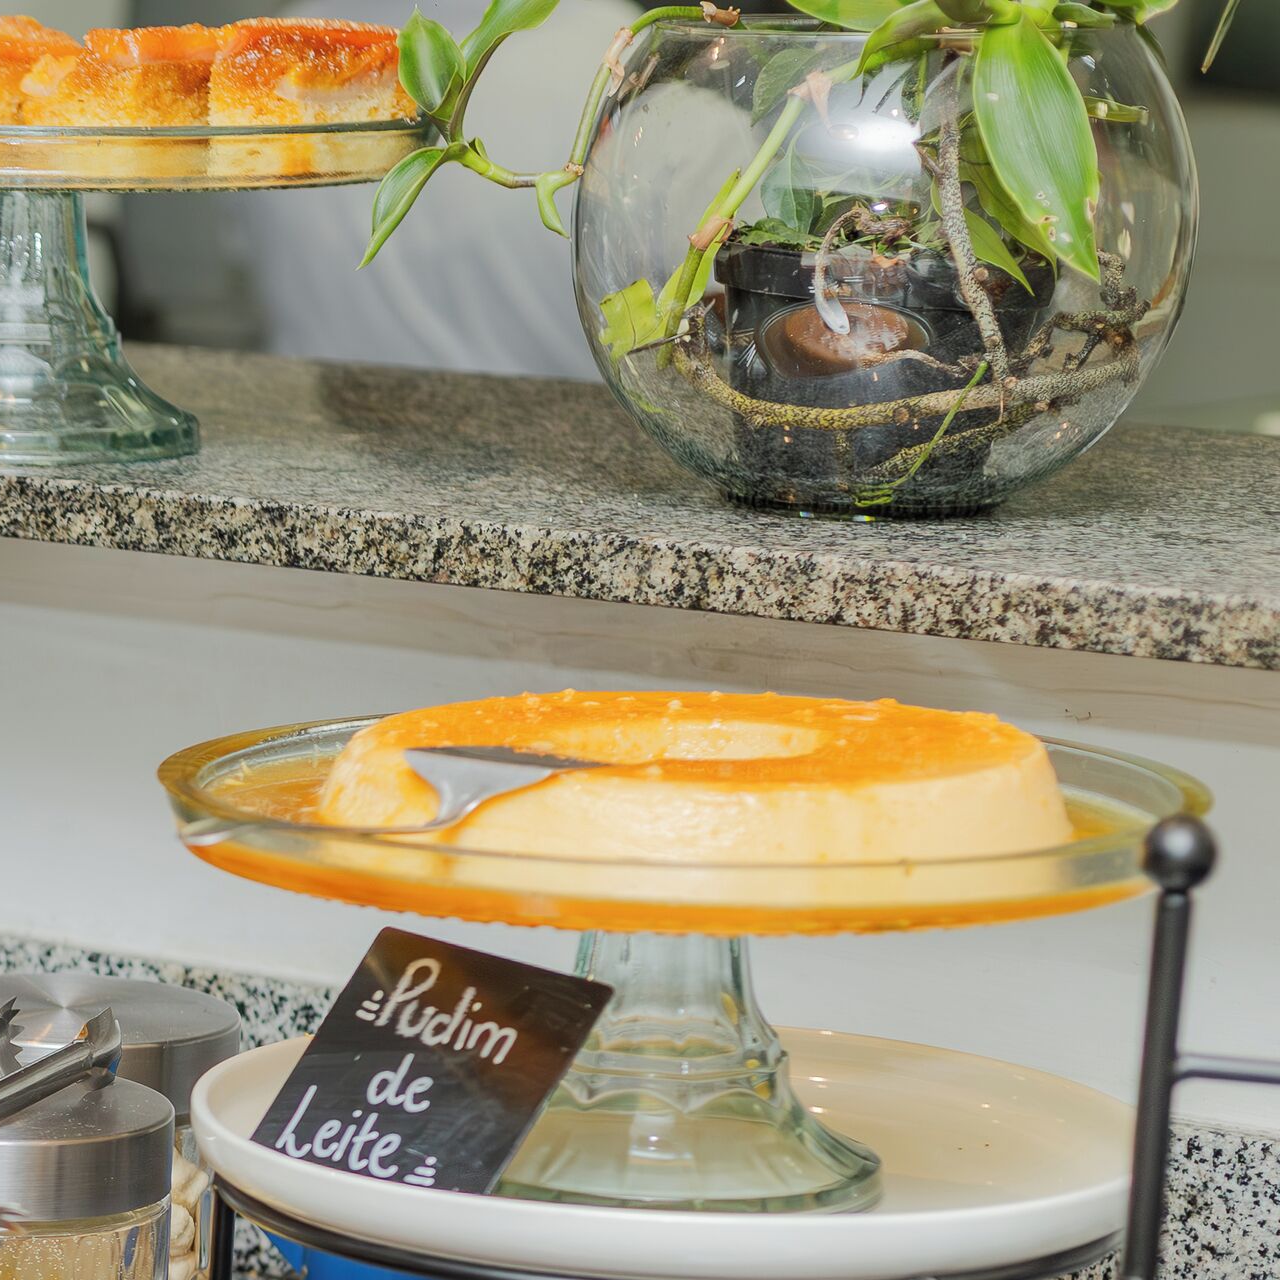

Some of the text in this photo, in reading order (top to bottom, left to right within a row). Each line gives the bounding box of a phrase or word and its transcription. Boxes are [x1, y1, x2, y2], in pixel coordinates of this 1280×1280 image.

[373, 957, 519, 1066] Pudim
[366, 1052, 434, 1114] de
[274, 1084, 402, 1179] Leite
